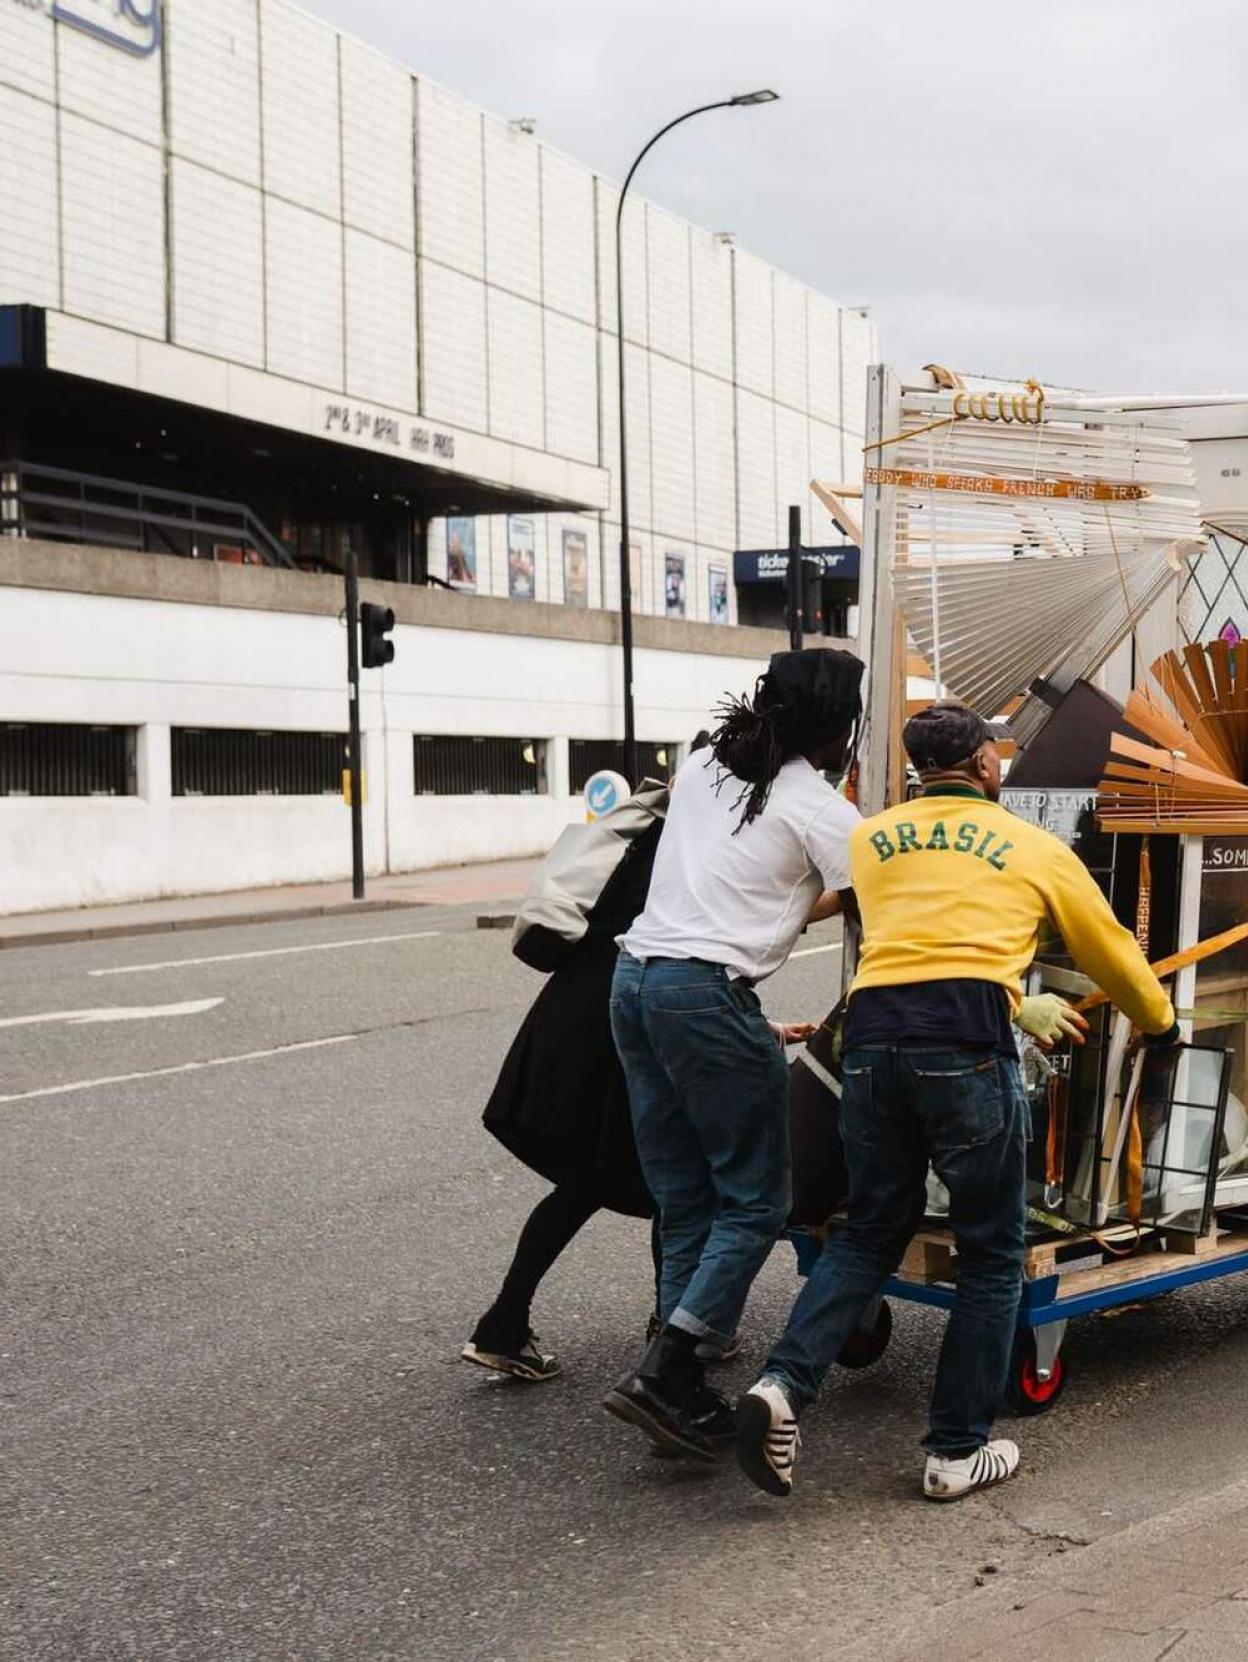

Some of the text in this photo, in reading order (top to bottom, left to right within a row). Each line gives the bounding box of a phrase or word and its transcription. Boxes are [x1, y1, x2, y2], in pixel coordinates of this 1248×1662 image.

[911, 474, 937, 489] WHO
[1002, 481, 1054, 496] FRENCH
[1047, 792, 1099, 811] START
[869, 819, 1014, 871] BRASIL
